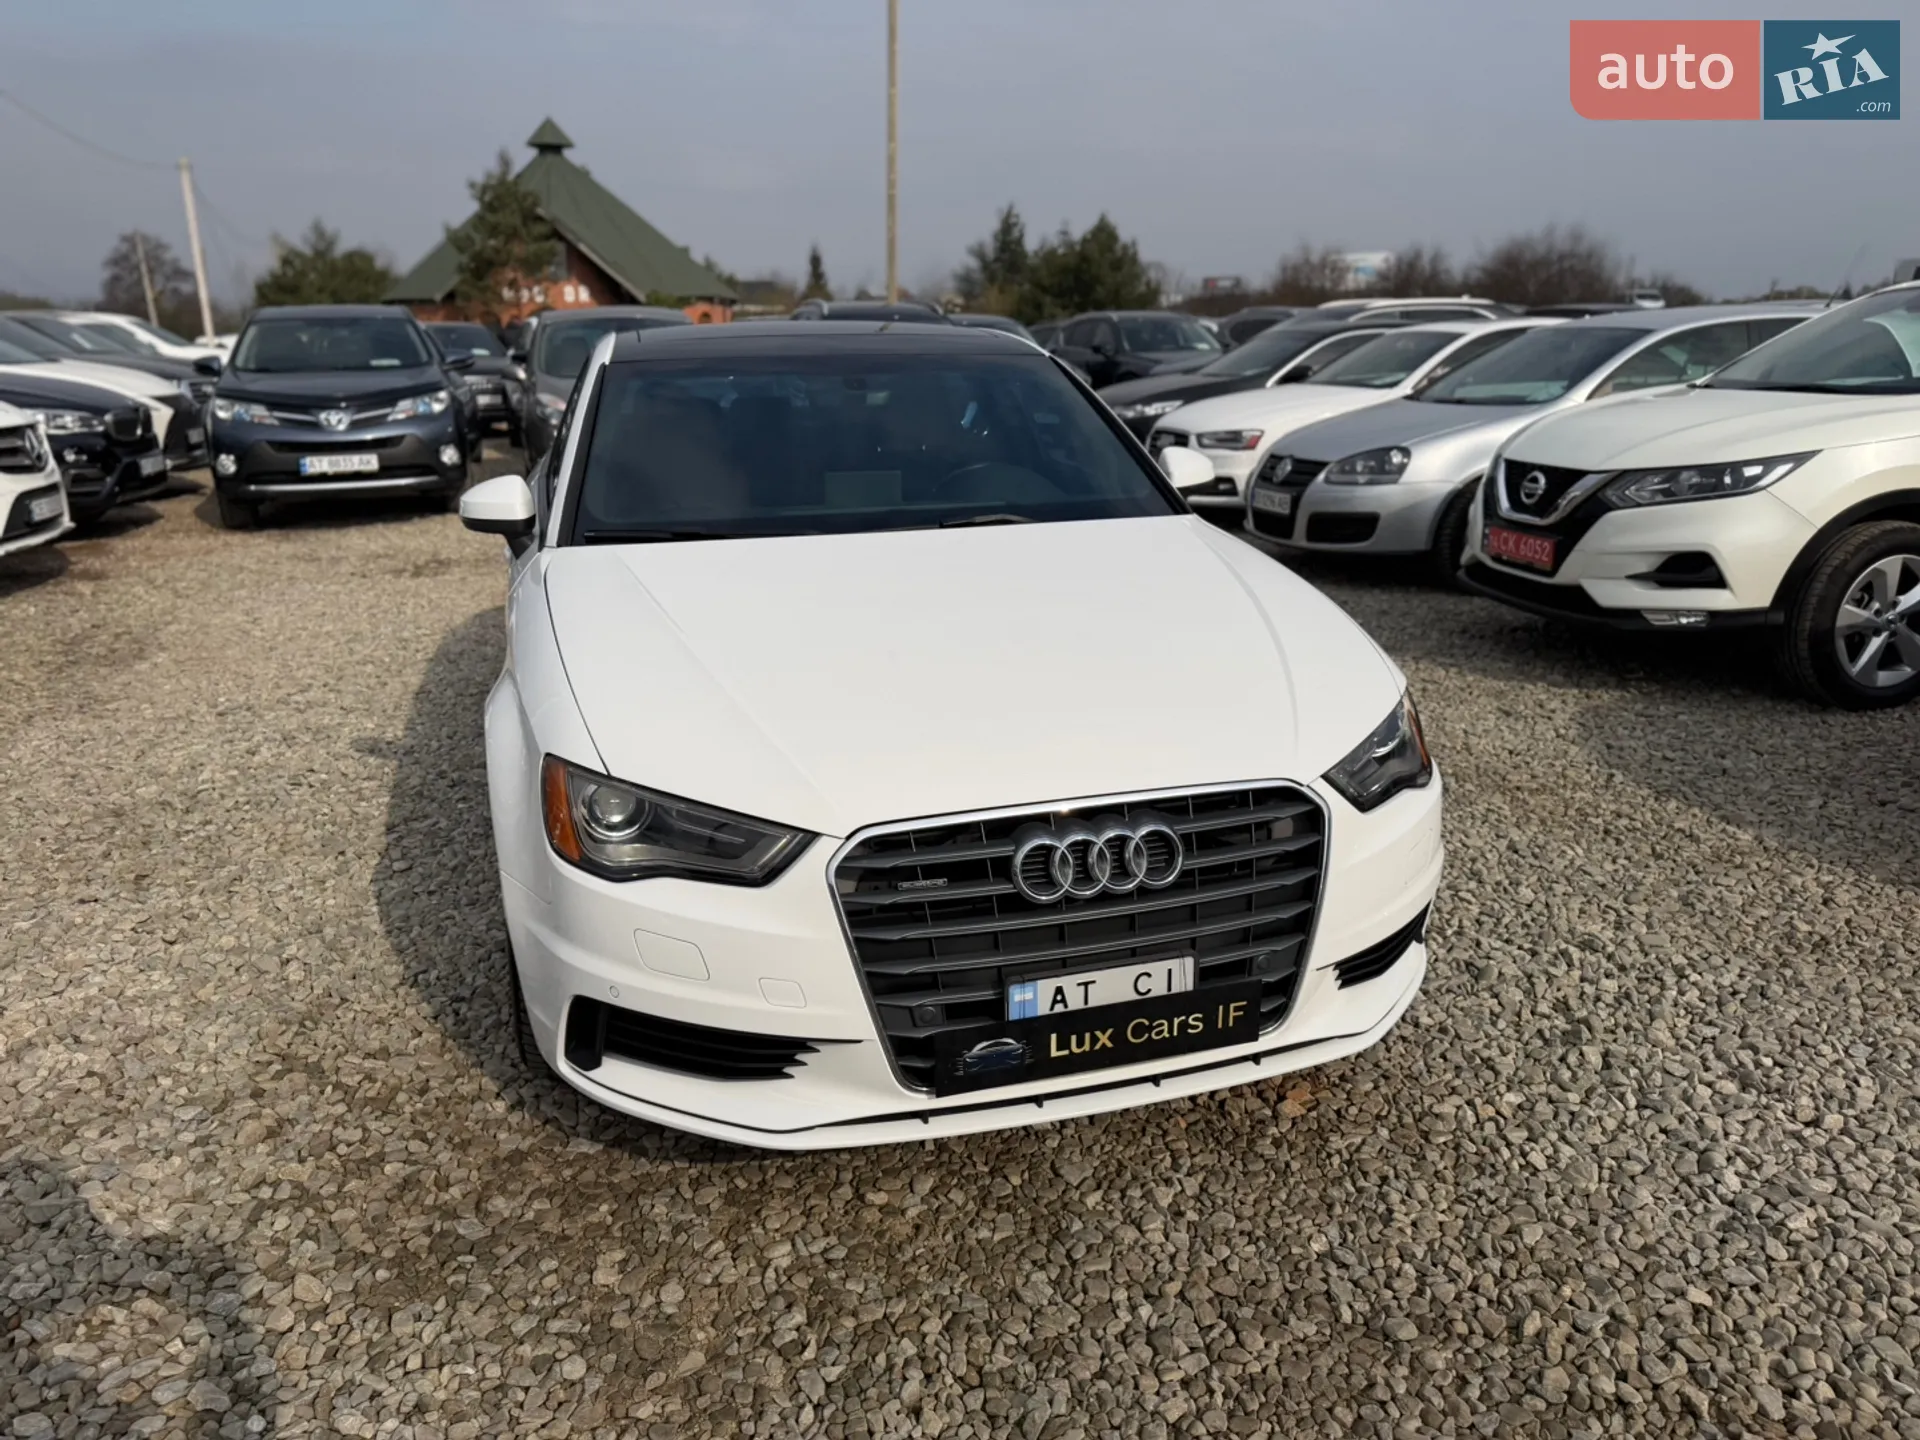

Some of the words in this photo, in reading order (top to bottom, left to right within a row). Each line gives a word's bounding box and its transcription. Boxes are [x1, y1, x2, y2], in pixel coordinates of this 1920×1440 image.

[1499, 532, 1516, 553] CK
[1519, 537, 1551, 562] 6052
[1049, 980, 1096, 1011] AT
[1050, 1028, 1114, 1057] Lux
[1126, 1013, 1204, 1043] Cars
[1217, 1001, 1247, 1028] IF
